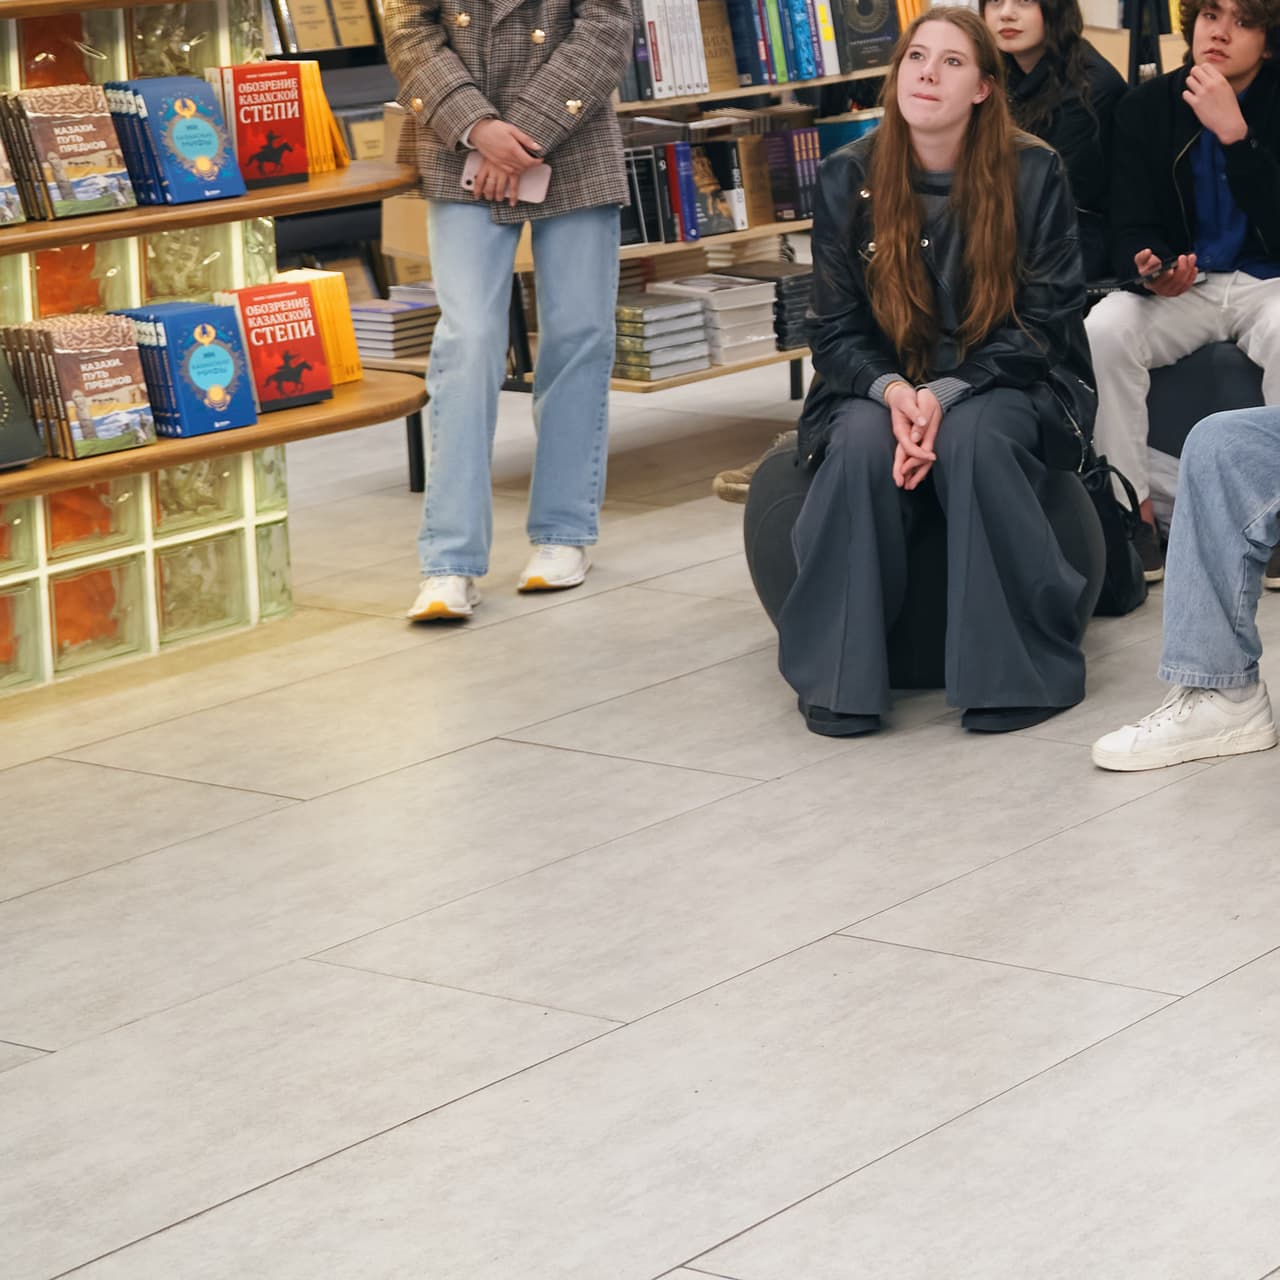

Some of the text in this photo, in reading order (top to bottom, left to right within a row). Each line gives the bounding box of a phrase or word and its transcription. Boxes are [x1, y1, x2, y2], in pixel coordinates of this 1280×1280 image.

[238, 78, 298, 93] ОБОЗРЕНИЕ
[239, 89, 299, 105] КАЗАХСКОЙ
[240, 103, 300, 124] СТЕПИ
[53, 123, 96, 136] КАЗАХИ.
[56, 135, 84, 144] ПУТЬ
[58, 140, 107, 154] ПРЕДКОВ
[246, 297, 310, 317] ОБОЗРЕНИЕ
[248, 308, 312, 328] КАЗАХСКОЙ
[250, 325, 316, 346] СТЕПИ
[80, 359, 123, 372] КАЗАХИ.
[82, 371, 110, 381] ПУТЬ
[84, 376, 133, 390] ПРЕДКОВ
